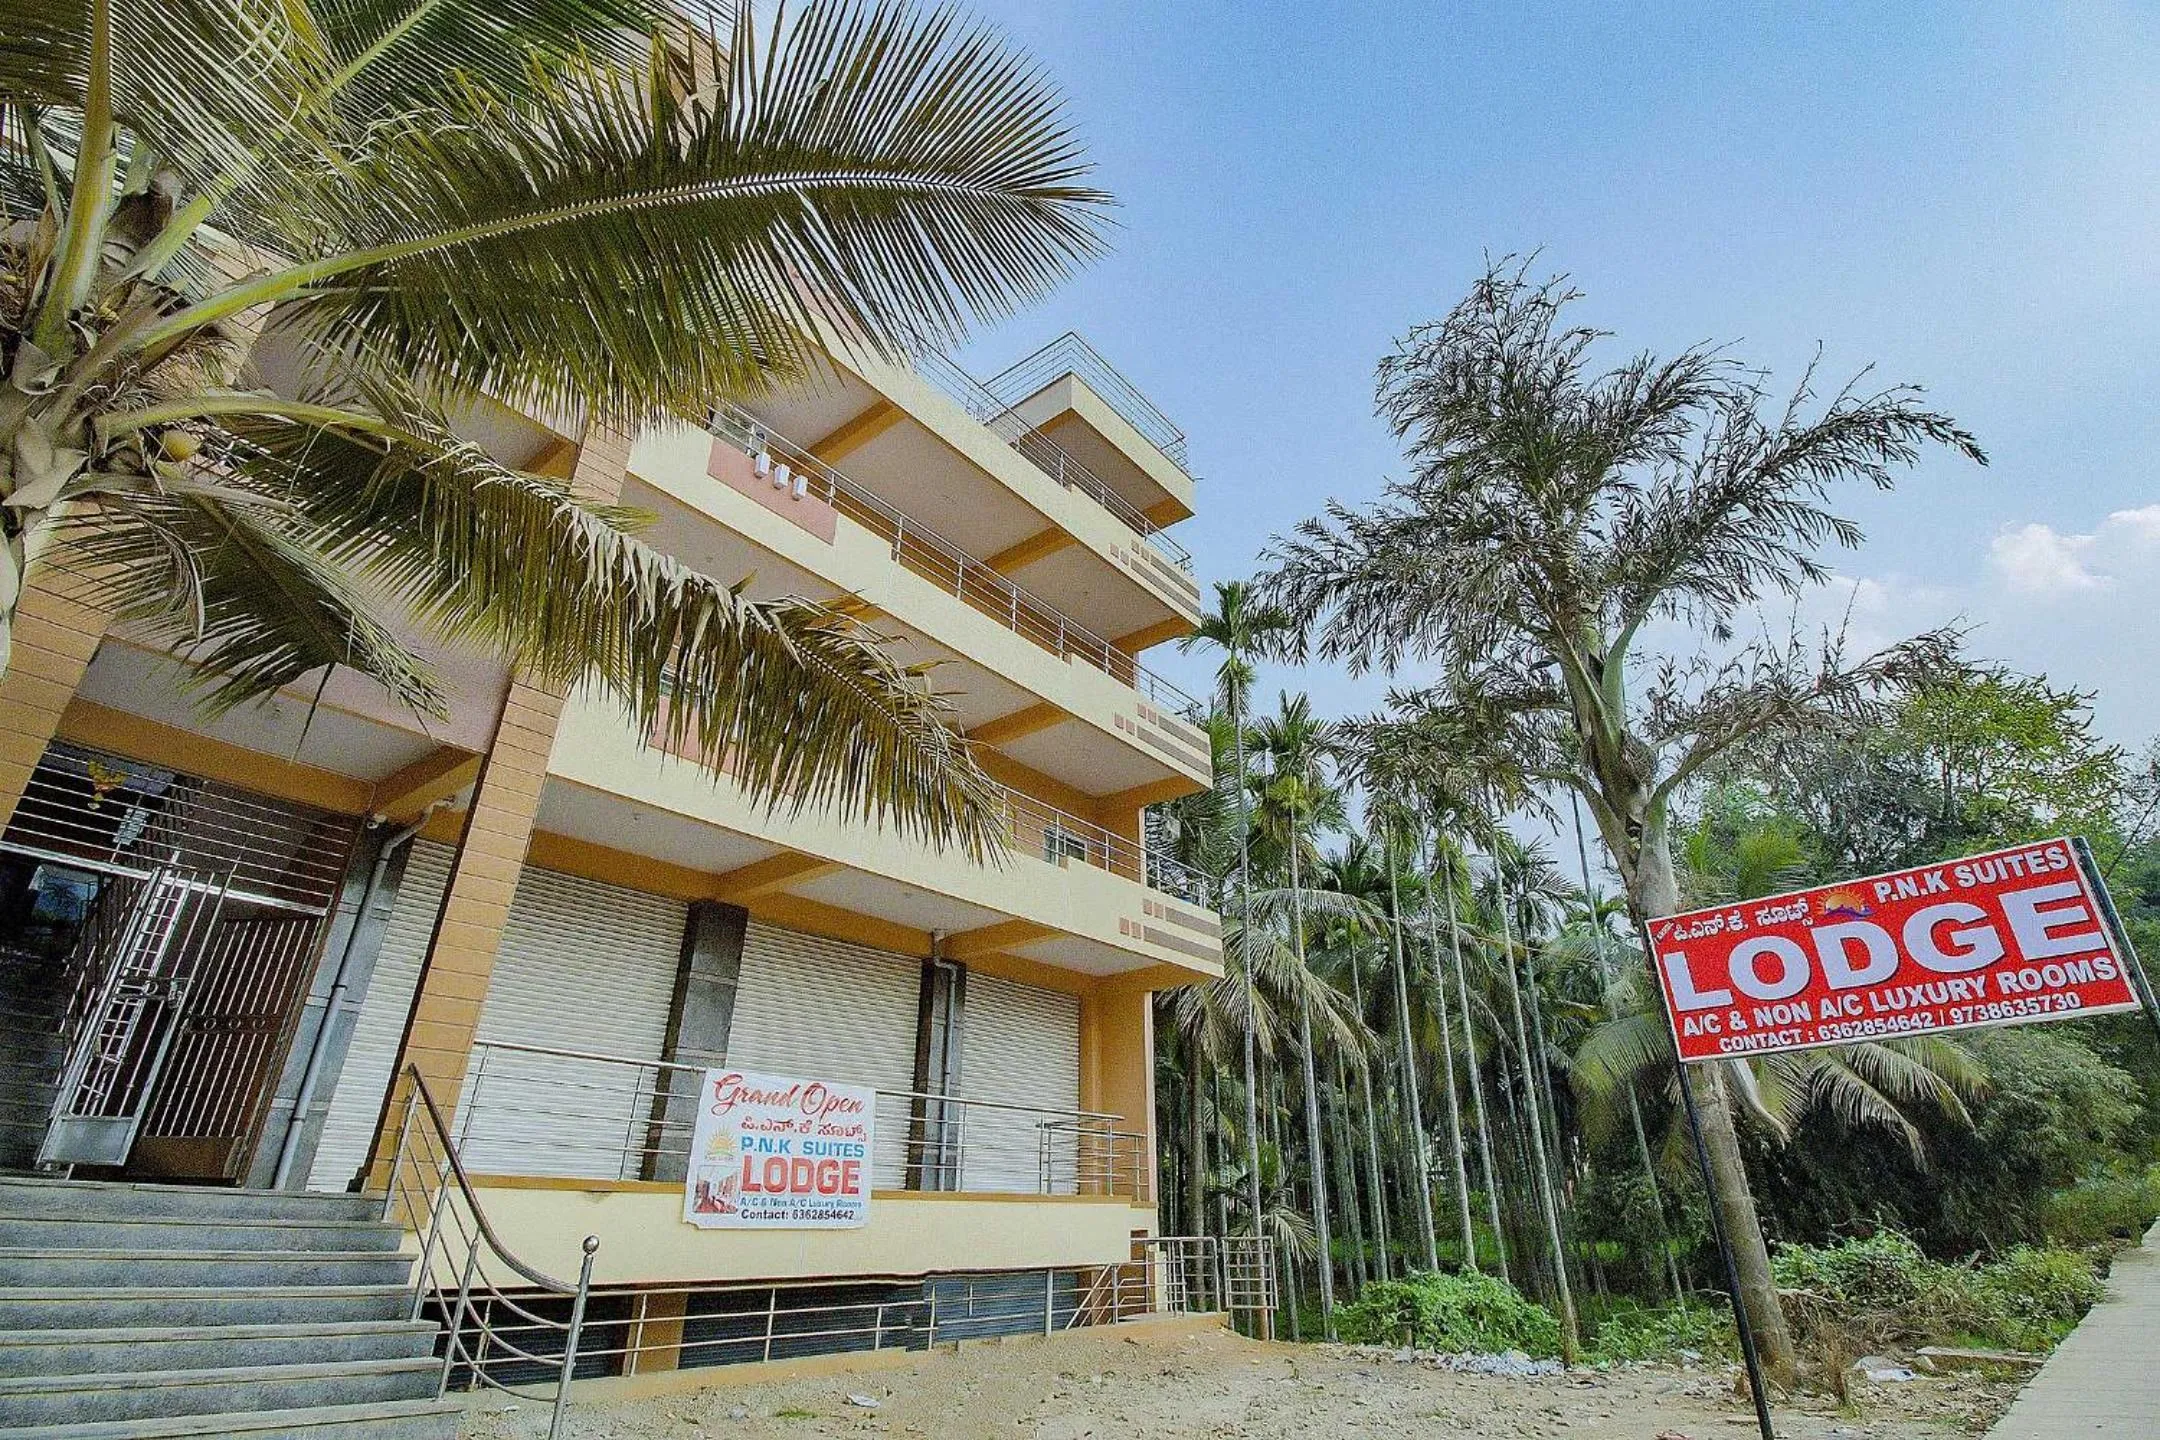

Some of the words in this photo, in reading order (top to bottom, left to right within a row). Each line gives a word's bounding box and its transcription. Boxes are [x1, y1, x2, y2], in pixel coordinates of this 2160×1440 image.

[1873, 870, 1949, 903] P.N.K
[1954, 847, 2069, 888] SUITES
[1662, 881, 2108, 1011] LODGE
[1683, 1013, 1722, 1037] A/C
[1730, 1010, 1748, 1031] &
[1754, 1001, 1812, 1028] NON
[1821, 994, 1863, 1019] A/C
[1871, 975, 1986, 1012] LUXURY
[1996, 957, 2119, 994] ROOMS
[1719, 1029, 1802, 1052] CONTACT
[1818, 1012, 1934, 1041] 6362854642
[1950, 992, 2081, 1024] 9738635730
[711, 1074, 800, 1116] Grand
[801, 1082, 865, 1122] Open
[741, 1135, 791, 1154] P.N.K
[803, 1141, 864, 1157] SUITES
[741, 1155, 860, 1195] LODGE
[741, 1209, 788, 1220] Contact:
